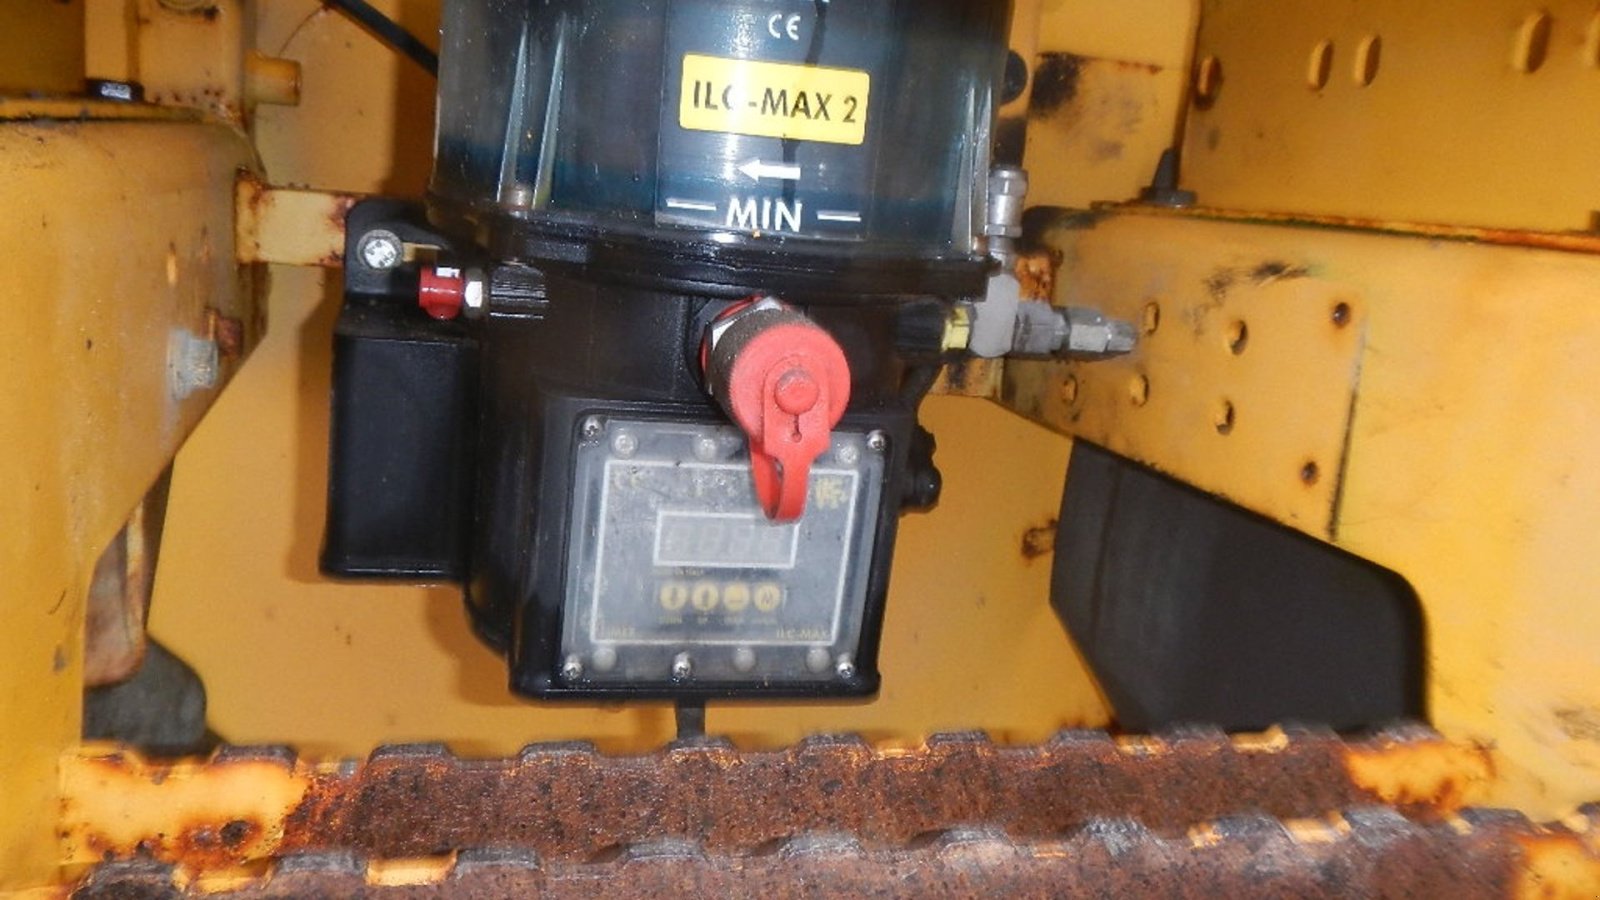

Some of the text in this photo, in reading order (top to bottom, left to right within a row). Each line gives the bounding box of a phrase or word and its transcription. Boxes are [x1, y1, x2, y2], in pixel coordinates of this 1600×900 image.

[768, 13, 801, 41] CE
[843, 96, 858, 123] 2
[725, 196, 803, 232] MIN
